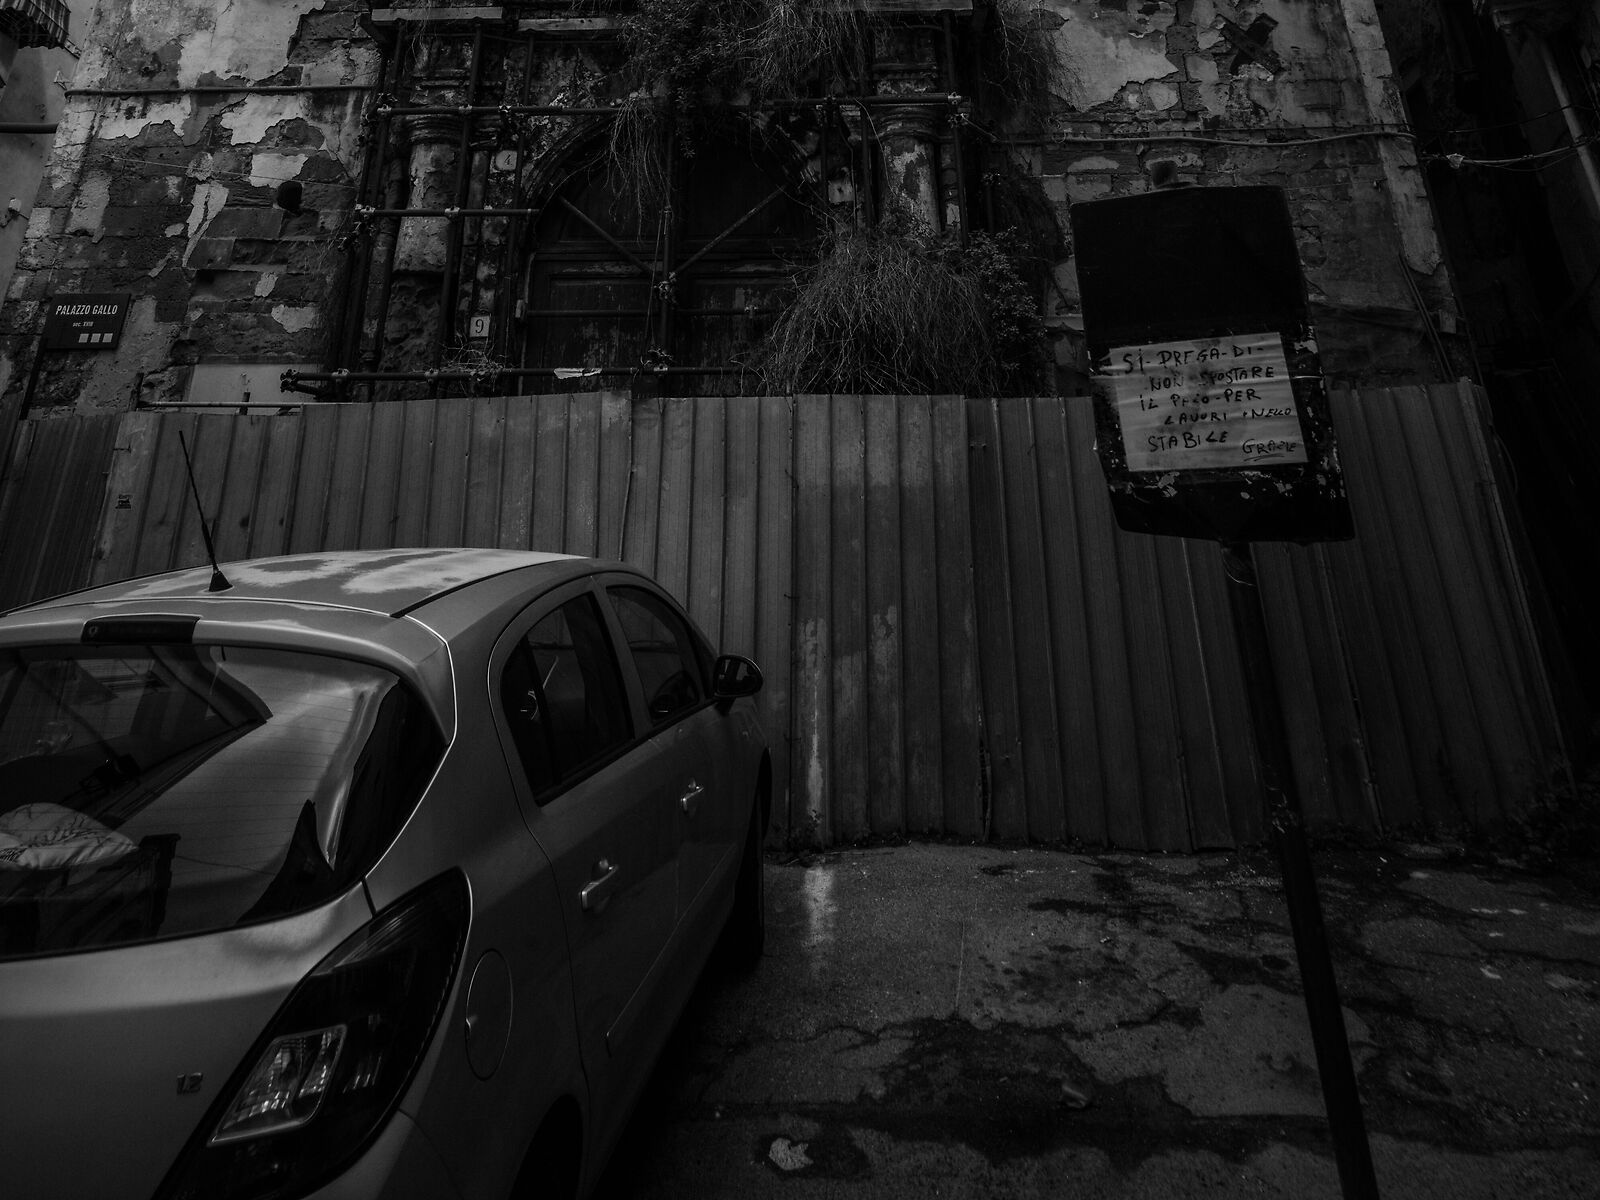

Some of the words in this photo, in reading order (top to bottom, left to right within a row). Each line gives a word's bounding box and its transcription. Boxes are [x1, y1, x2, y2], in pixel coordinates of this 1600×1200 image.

[55, 304, 91, 315] PALAZZO
[92, 304, 118, 315] GALLO
[475, 318, 484, 334] 9
[1150, 375, 1185, 392] NON
[1147, 431, 1229, 453] STABILE
